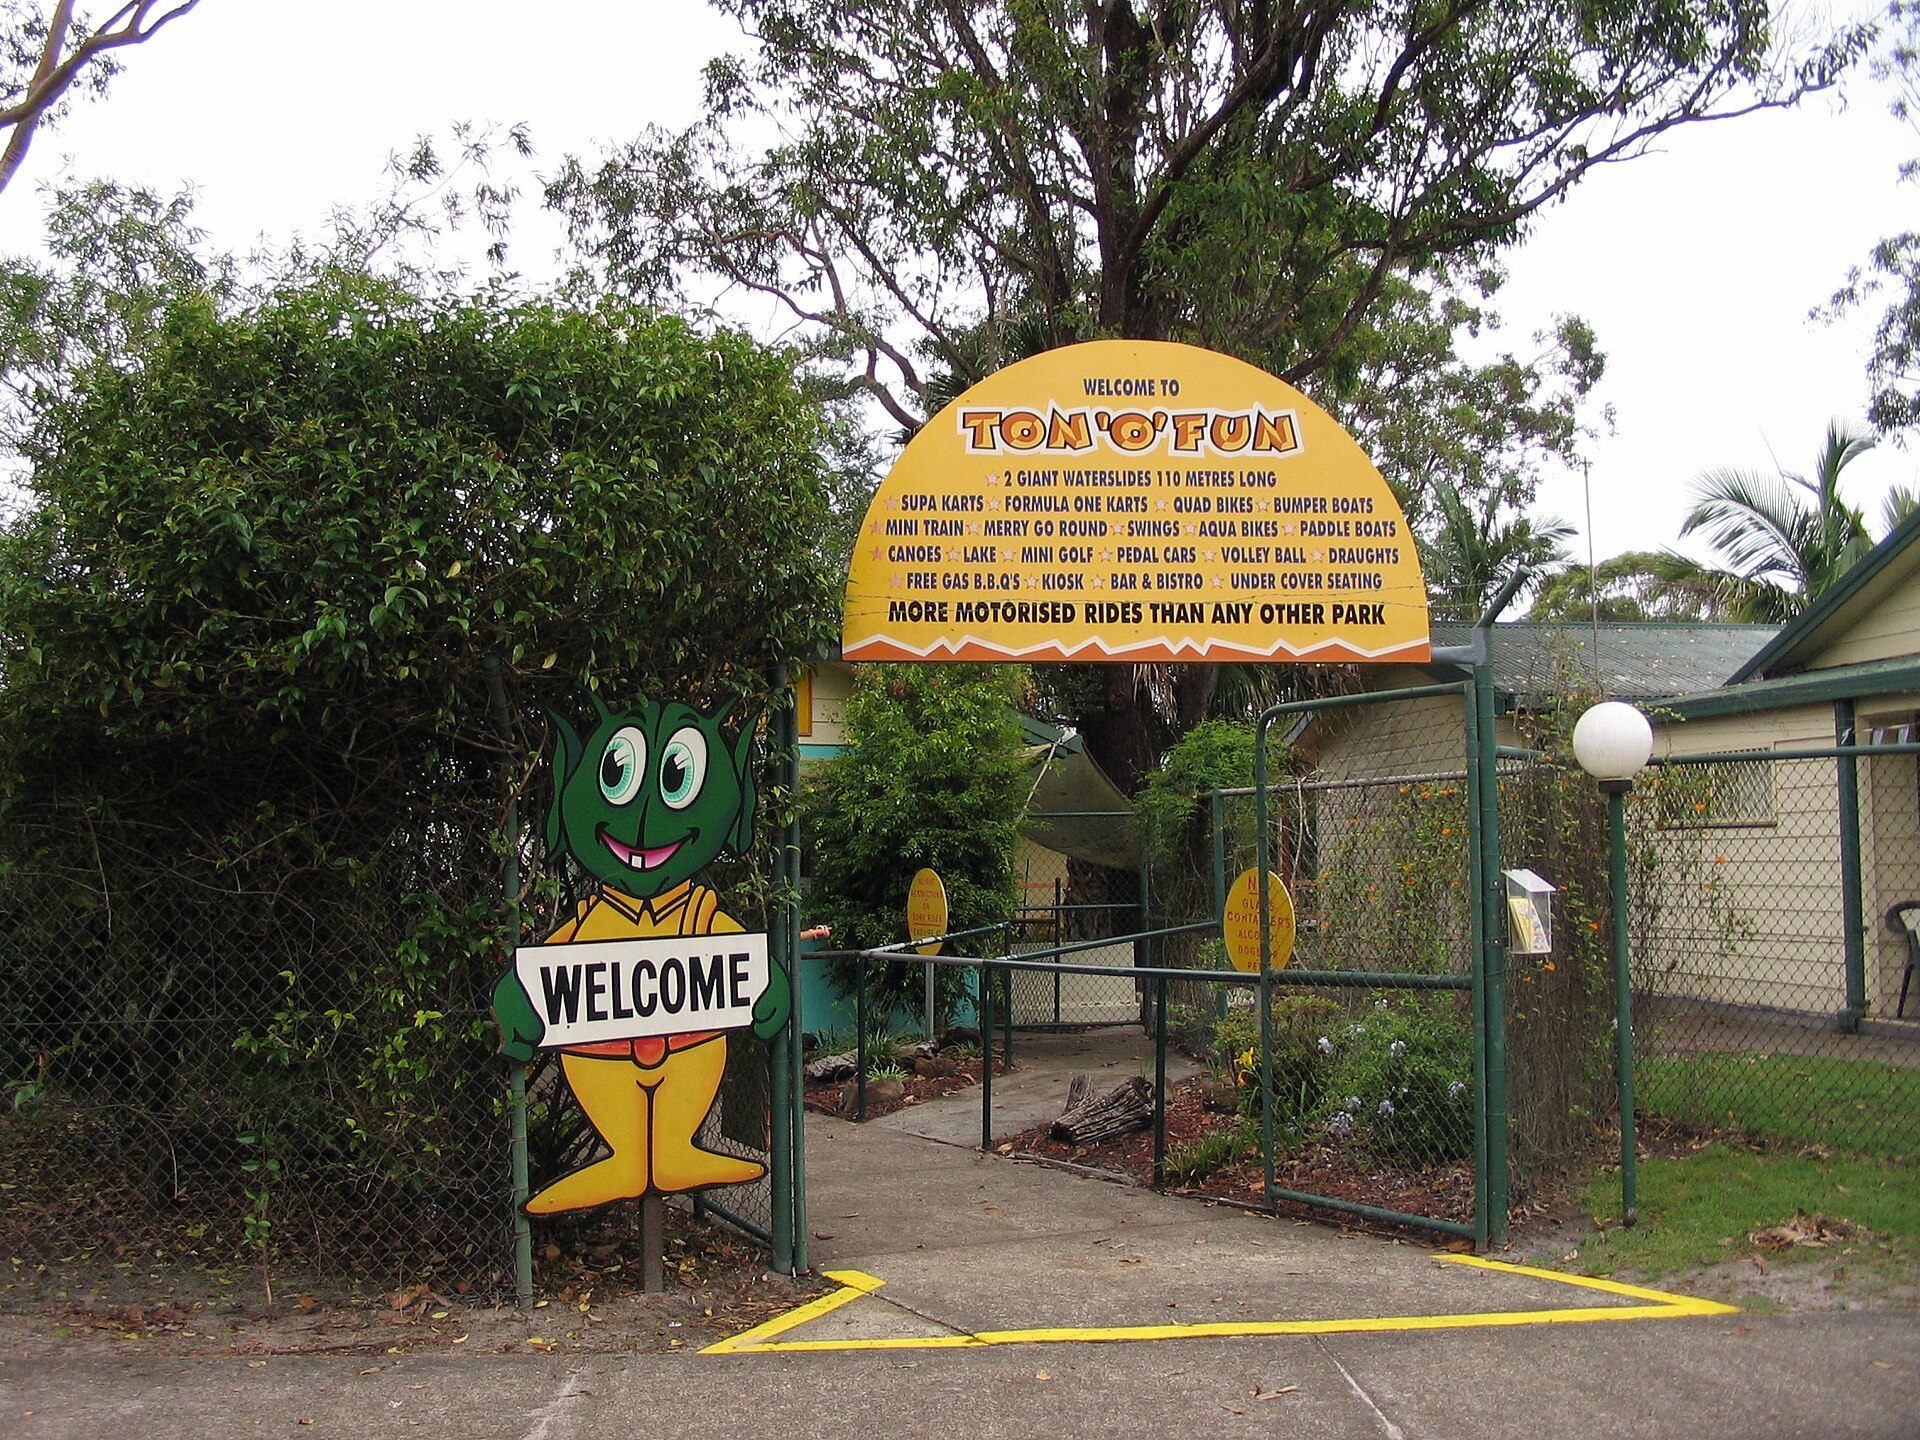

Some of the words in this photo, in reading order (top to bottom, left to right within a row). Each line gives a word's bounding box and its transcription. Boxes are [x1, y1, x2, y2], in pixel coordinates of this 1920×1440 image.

[1083, 378, 1156, 397] WELCOME
[1160, 379, 1180, 397] TO
[1004, 470, 1012, 487] 2
[1016, 470, 1059, 487] GIANT
[1062, 470, 1152, 487] WATERSLIDES
[1157, 470, 1181, 487] 110
[1185, 470, 1235, 488] METRES
[1239, 470, 1277, 488] LONG
[901, 494, 938, 512] SUPA
[941, 494, 984, 512] KARTS
[1005, 495, 1070, 513] FORMULA
[1073, 495, 1102, 513] ONE
[1106, 496, 1148, 513] KARTS
[1173, 496, 1212, 514] QUAD
[1216, 496, 1254, 514] BIKES
[1273, 496, 1328, 514] BUMPER
[1332, 497, 1374, 514] BOATS
[885, 518, 919, 536] MINI
[923, 519, 964, 537] TRAIN
[983, 519, 1030, 537] MERRY
[1033, 519, 1054, 537] GO
[1059, 519, 1108, 537] ROUND
[1127, 519, 1180, 537] SWINGS
[1198, 520, 1237, 538] AQUA
[1241, 520, 1279, 538] BIKES
[1300, 520, 1351, 537] PADDLE
[1354, 520, 1396, 538] BOATS
[887, 545, 942, 563] CANOES
[963, 546, 997, 563] LAKE
[1021, 546, 1054, 563] MINI
[1058, 546, 1094, 564] GOLF
[1117, 546, 1160, 564] PEDAL
[1163, 546, 1197, 564] CARS
[1220, 546, 1271, 564] VOLLEY
[1274, 546, 1307, 564] BALL
[1328, 547, 1400, 565] DRAUGHTS
[906, 572, 938, 590] FREE
[942, 572, 970, 590] GAS
[974, 572, 1021, 591] B.B.Q'S
[1042, 572, 1085, 591] KIOSK
[1110, 573, 1138, 590] BAR
[1141, 572, 1153, 590] &
[1156, 572, 1204, 590] BISTRO
[1230, 572, 1276, 590] UNDER
[1280, 572, 1323, 590] COVER
[1327, 572, 1383, 591] SEATING
[887, 601, 949, 623] MORE
[955, 601, 1076, 624] MOTORISED
[1084, 601, 1143, 624] RIDES
[1149, 603, 1205, 624] THAN
[1211, 603, 1252, 625] ANY
[1259, 603, 1326, 625] OTHER
[1332, 603, 1386, 626] PARK
[1242, 898, 1276, 912] GLAS
[1227, 911, 1291, 928] CONTAERS
[539, 952, 751, 1026] WELCOME
